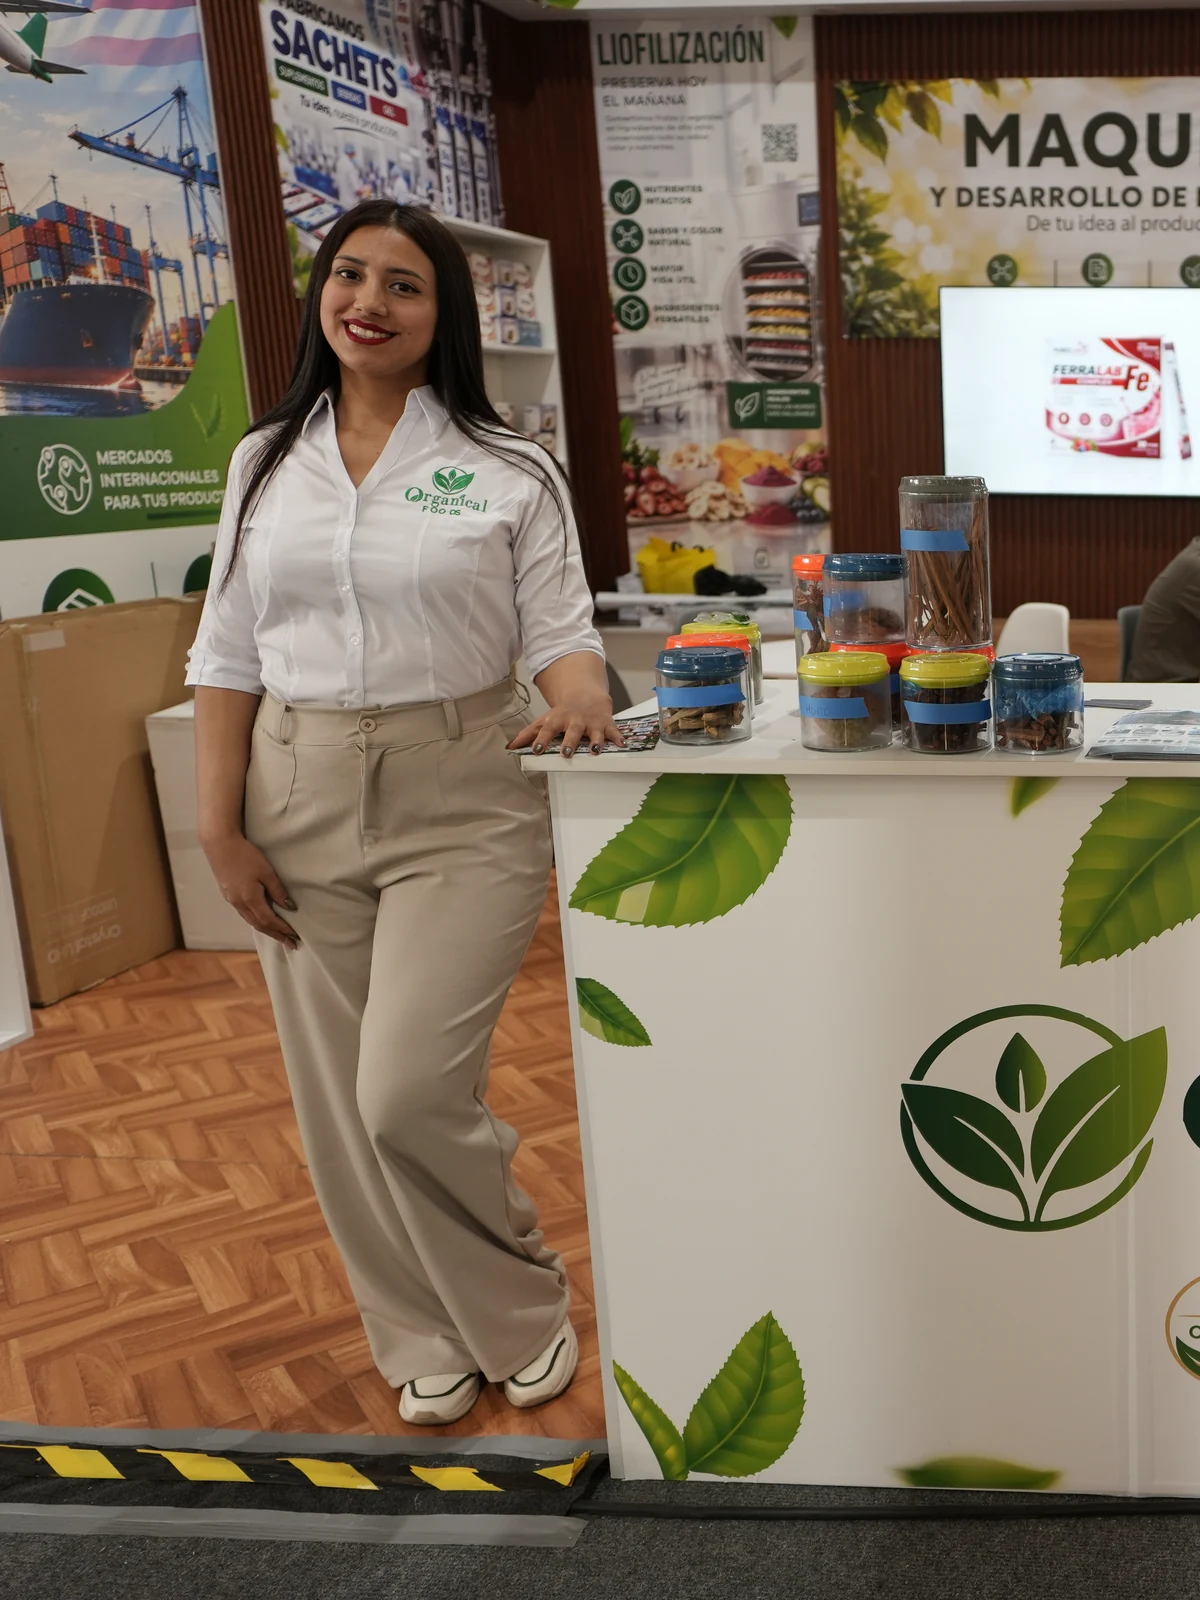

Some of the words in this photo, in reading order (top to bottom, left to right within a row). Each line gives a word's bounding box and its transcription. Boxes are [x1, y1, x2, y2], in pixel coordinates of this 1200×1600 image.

[270, 9, 397, 98] SACHETS
[596, 24, 765, 66] LIOFILIZACIÓN
[600, 76, 676, 88] PRESERVA
[678, 75, 708, 87] HOY
[602, 95, 619, 107] EL
[623, 91, 687, 106] MAÑANA
[930, 186, 947, 208] Y
[956, 186, 1143, 209] DESARROLLO
[1152, 186, 1187, 208] DE
[1026, 214, 1052, 232] De
[1055, 216, 1074, 232] tu
[1078, 214, 1116, 232] idea
[1121, 213, 1136, 232] al
[1053, 364, 1122, 376] FERRALAB
[1123, 364, 1150, 391] Fe
[96, 449, 173, 466] MERCADOS
[100, 469, 220, 488] INTERNACIONALES
[103, 495, 141, 511] PARA
[142, 492, 169, 508] TUS
[405, 486, 488, 513] Organical
